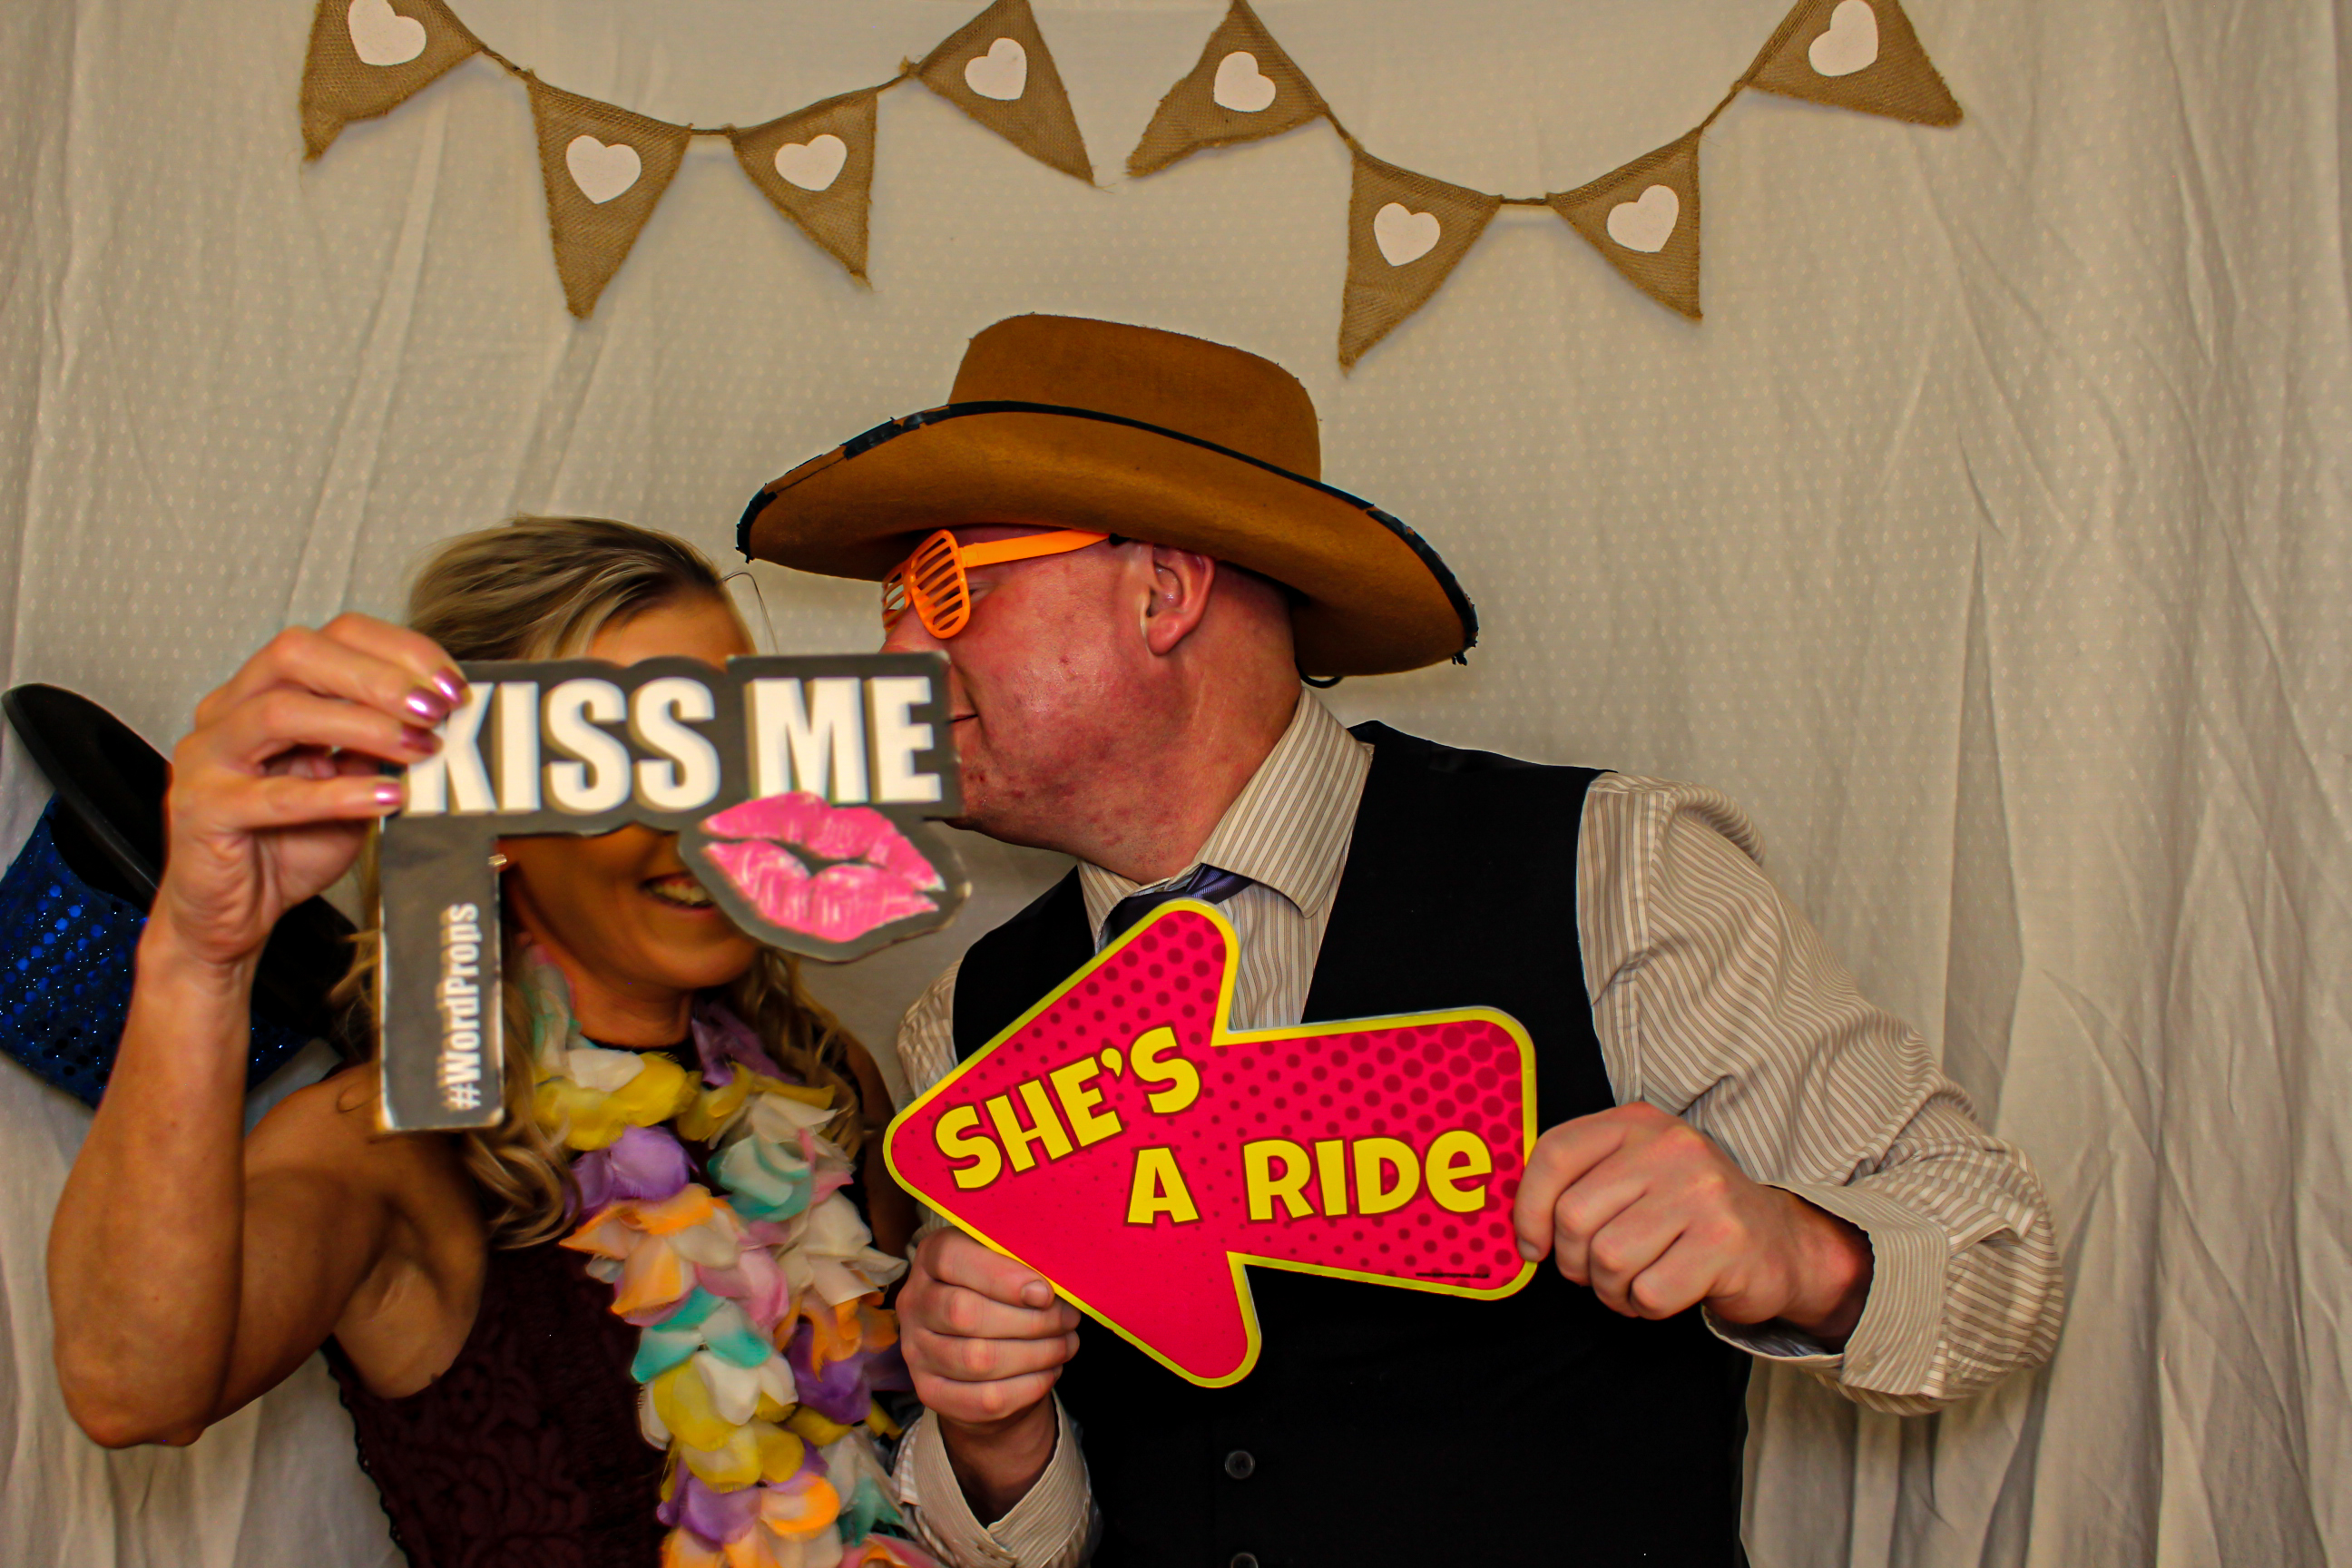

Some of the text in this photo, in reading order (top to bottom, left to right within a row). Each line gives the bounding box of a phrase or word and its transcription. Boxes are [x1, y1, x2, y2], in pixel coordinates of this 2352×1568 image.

[406, 676, 942, 813] KISS ME
[439, 903, 482, 1111] #WordProps
[934, 1025, 1200, 1190] SHE'S
[1126, 1146, 1200, 1225] A
